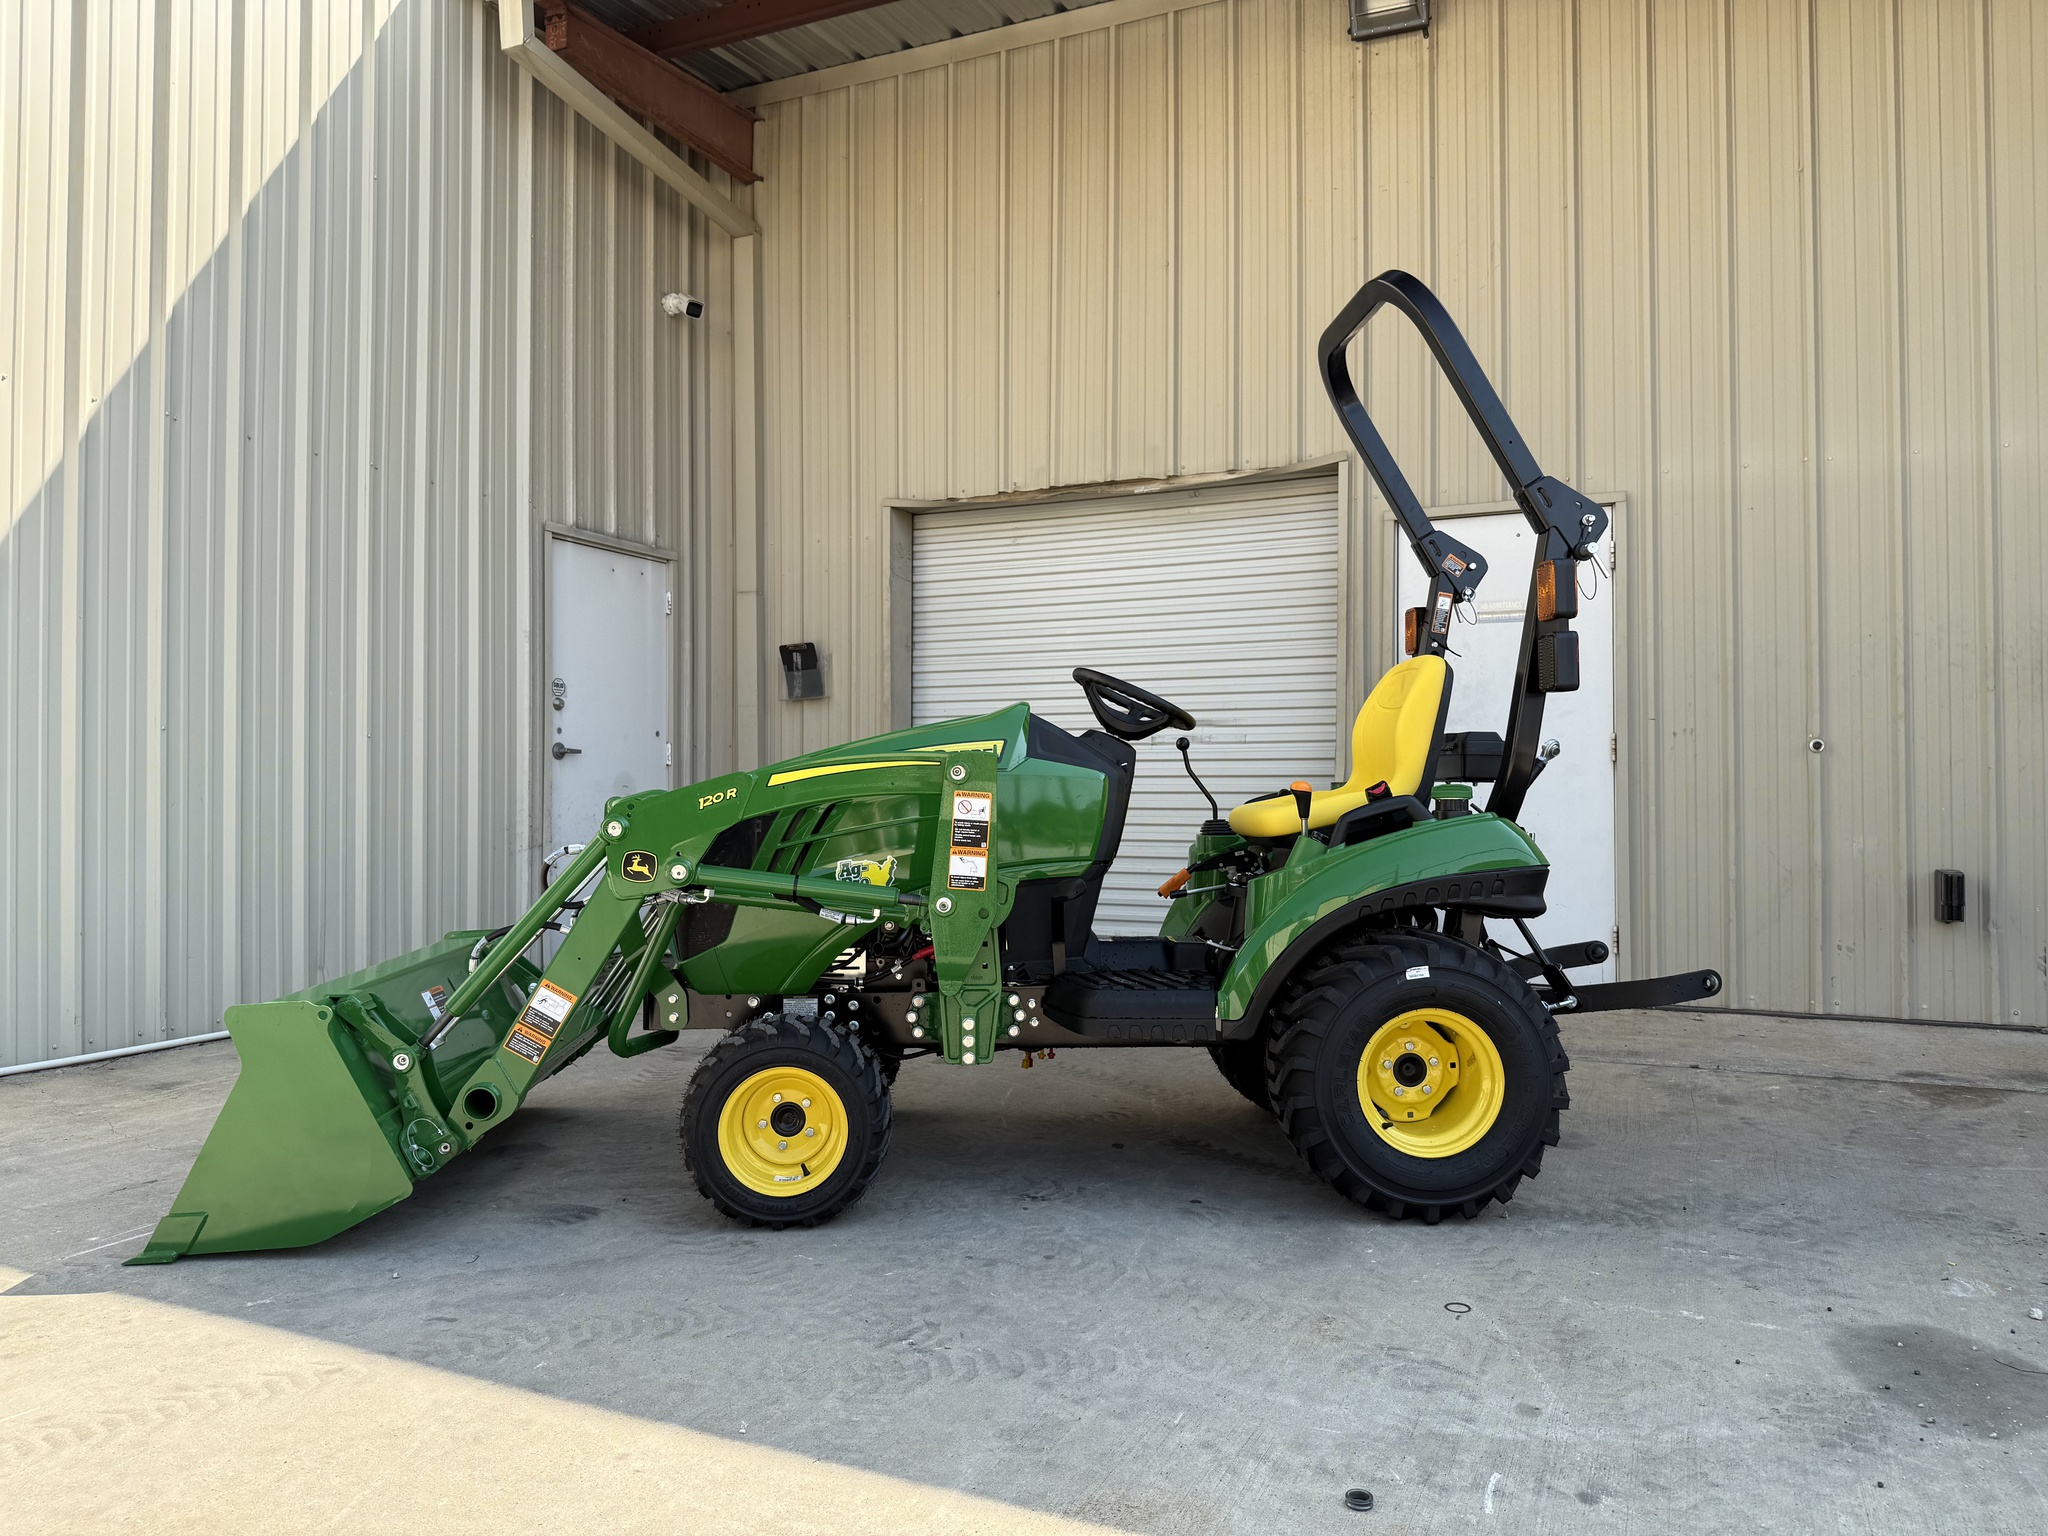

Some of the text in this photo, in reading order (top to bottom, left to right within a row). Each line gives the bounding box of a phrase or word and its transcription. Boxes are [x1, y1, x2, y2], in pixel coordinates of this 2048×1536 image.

[961, 791, 991, 800] WARNING
[957, 849, 987, 857] WARNING
[550, 985, 574, 1001] WARNING
[524, 1029, 547, 1045] WARNING
